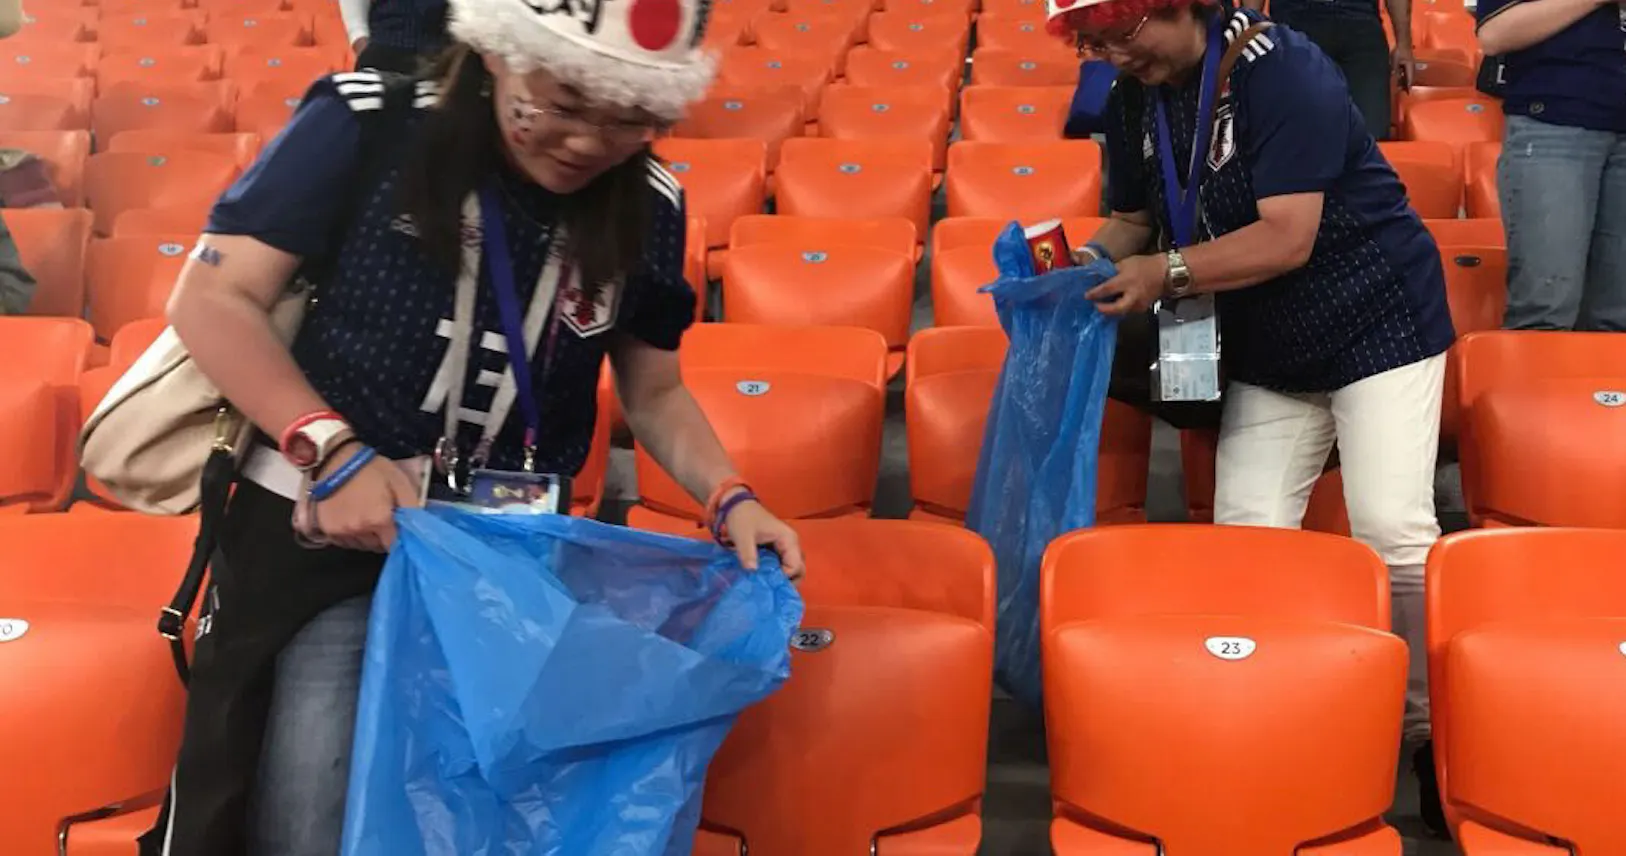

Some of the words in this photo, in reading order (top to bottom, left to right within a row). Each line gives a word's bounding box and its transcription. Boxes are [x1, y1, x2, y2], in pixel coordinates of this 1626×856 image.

[747, 383, 759, 393] 21
[1603, 393, 1618, 403] 24
[0, 623, 13, 636] 0
[800, 633, 819, 646] 22
[1221, 641, 1241, 655] 23
